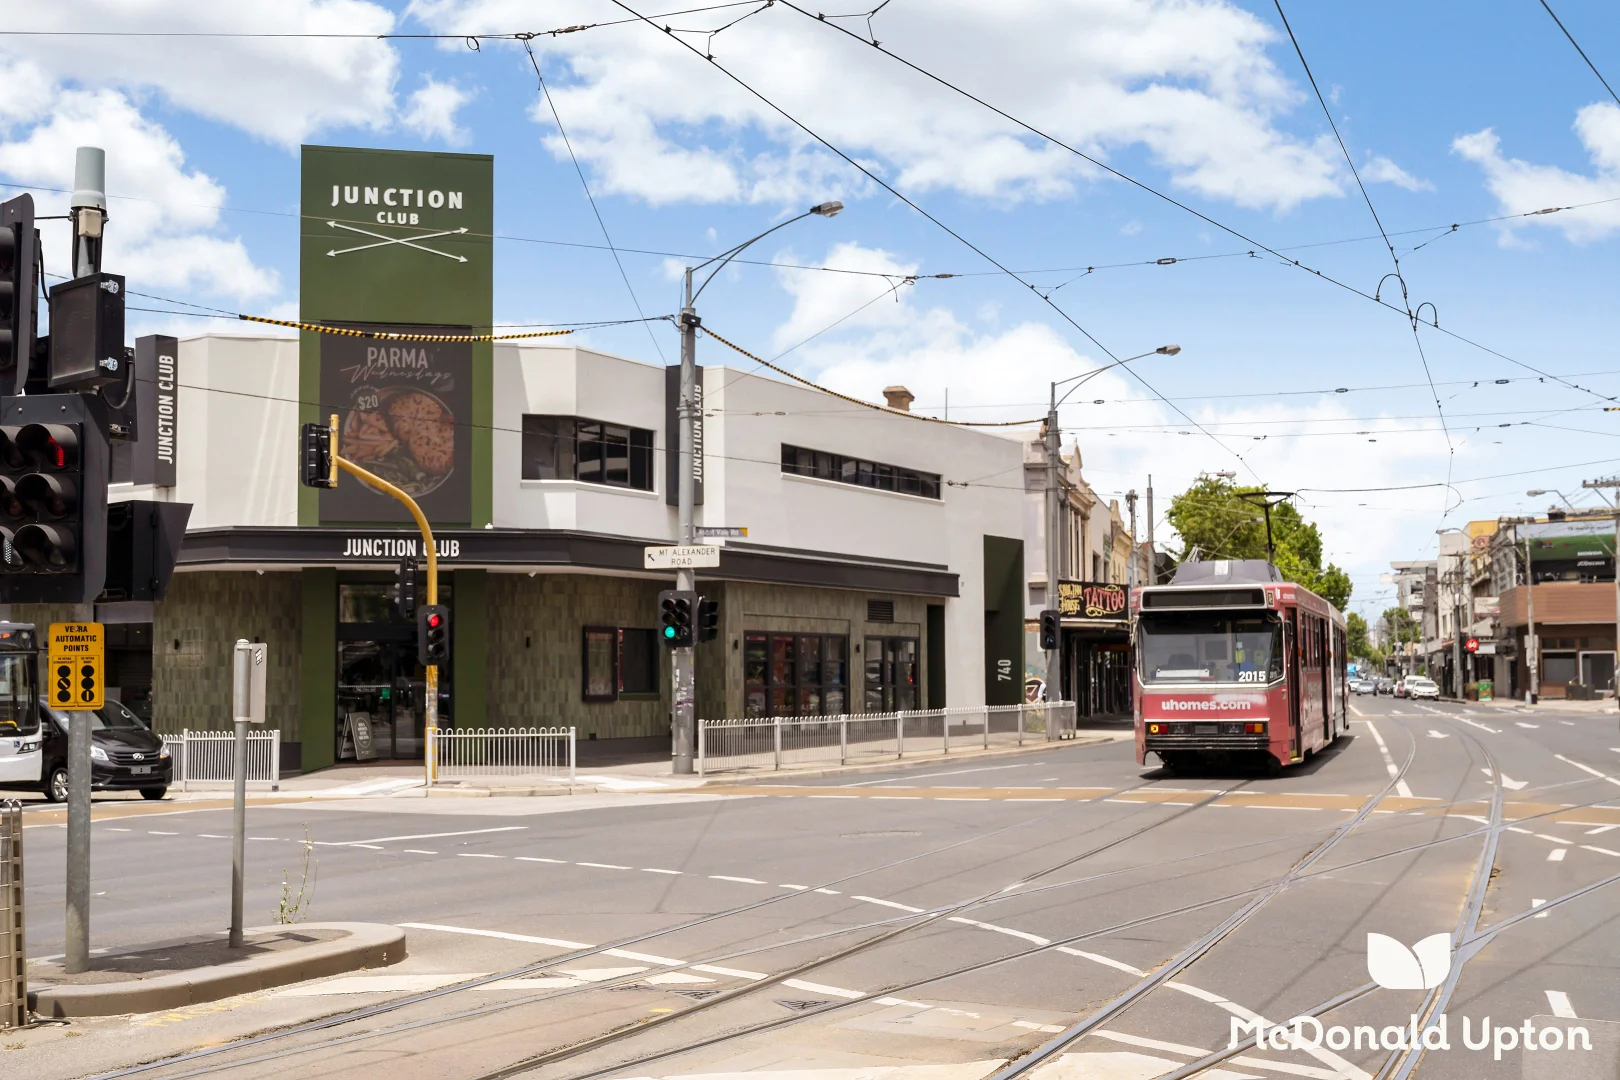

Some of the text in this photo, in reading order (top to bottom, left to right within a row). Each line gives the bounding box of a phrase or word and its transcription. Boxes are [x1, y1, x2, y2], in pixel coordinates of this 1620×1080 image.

[331, 185, 463, 209] JUNCTION
[376, 211, 419, 225] CLUB
[367, 347, 429, 369] PARMA
[340, 361, 451, 385] Wednesdays
[158, 354, 174, 465] JUNCTION CLUB
[357, 394, 379, 411] $20
[730, 527, 739, 536] Rd
[343, 538, 417, 557] JUNCTION
[659, 547, 716, 557] MT ALEXANDER
[671, 558, 692, 566] ROAD
[1084, 586, 1126, 612] TATTOO
[64, 625, 88, 633] VERA
[55, 635, 97, 643] AUTOMATIC
[63, 644, 89, 652] POINTS
[997, 659, 1012, 681] 740
[1238, 670, 1266, 682] 2015
[1161, 699, 1251, 711] uhomes.com
